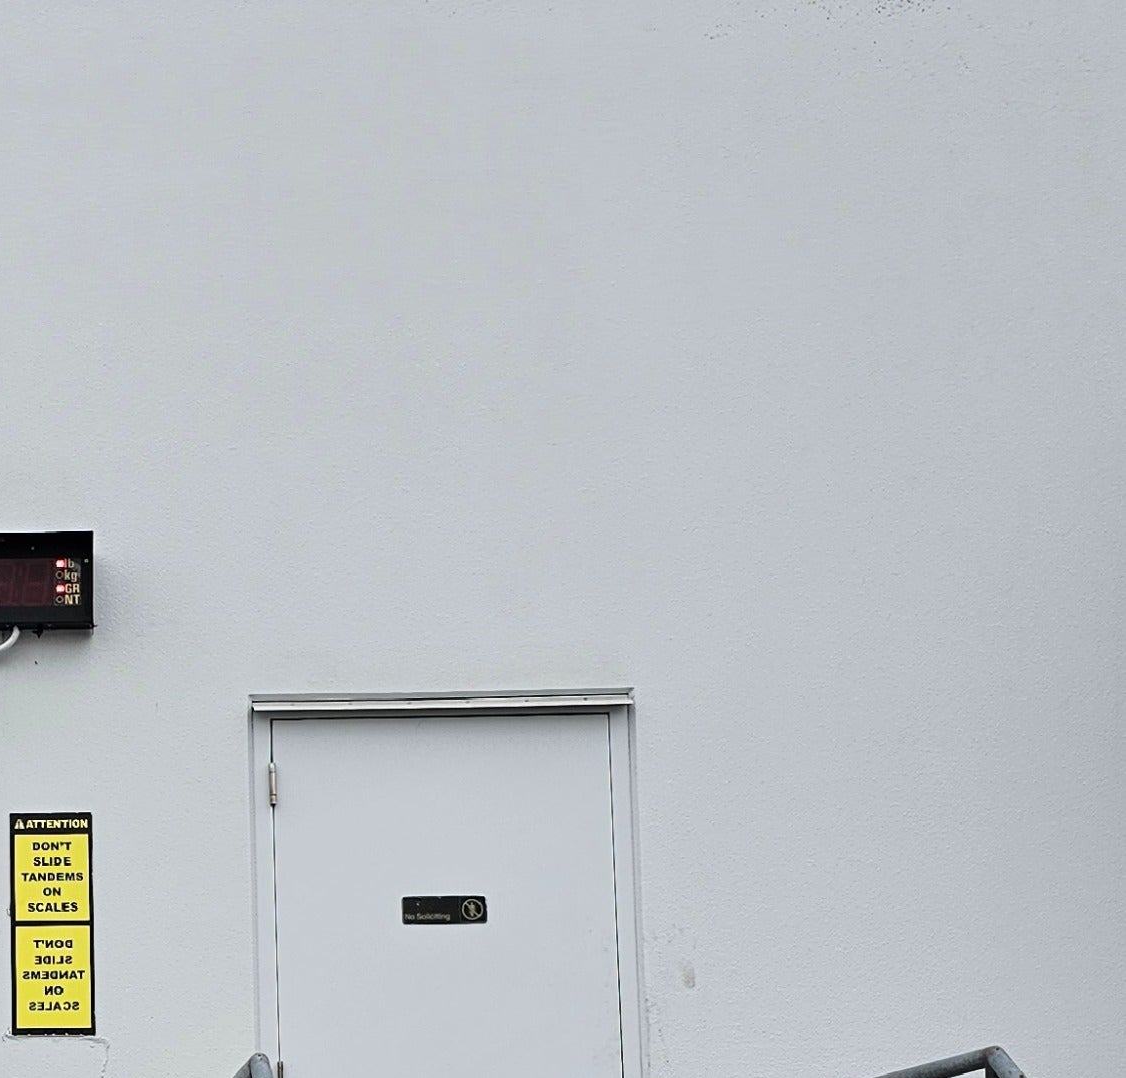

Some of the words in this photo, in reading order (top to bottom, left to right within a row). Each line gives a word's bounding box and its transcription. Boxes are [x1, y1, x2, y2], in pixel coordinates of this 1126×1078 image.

[64, 569, 78, 582] kg
[64, 583, 80, 593] GR
[64, 594, 81, 605] NT
[26, 819, 89, 829] ATTENTION
[32, 841, 72, 851] DON'T
[33, 856, 72, 867] SLIDE
[21, 872, 84, 882] TANDEMS
[42, 887, 62, 897] ON
[27, 902, 79, 913] SCALES
